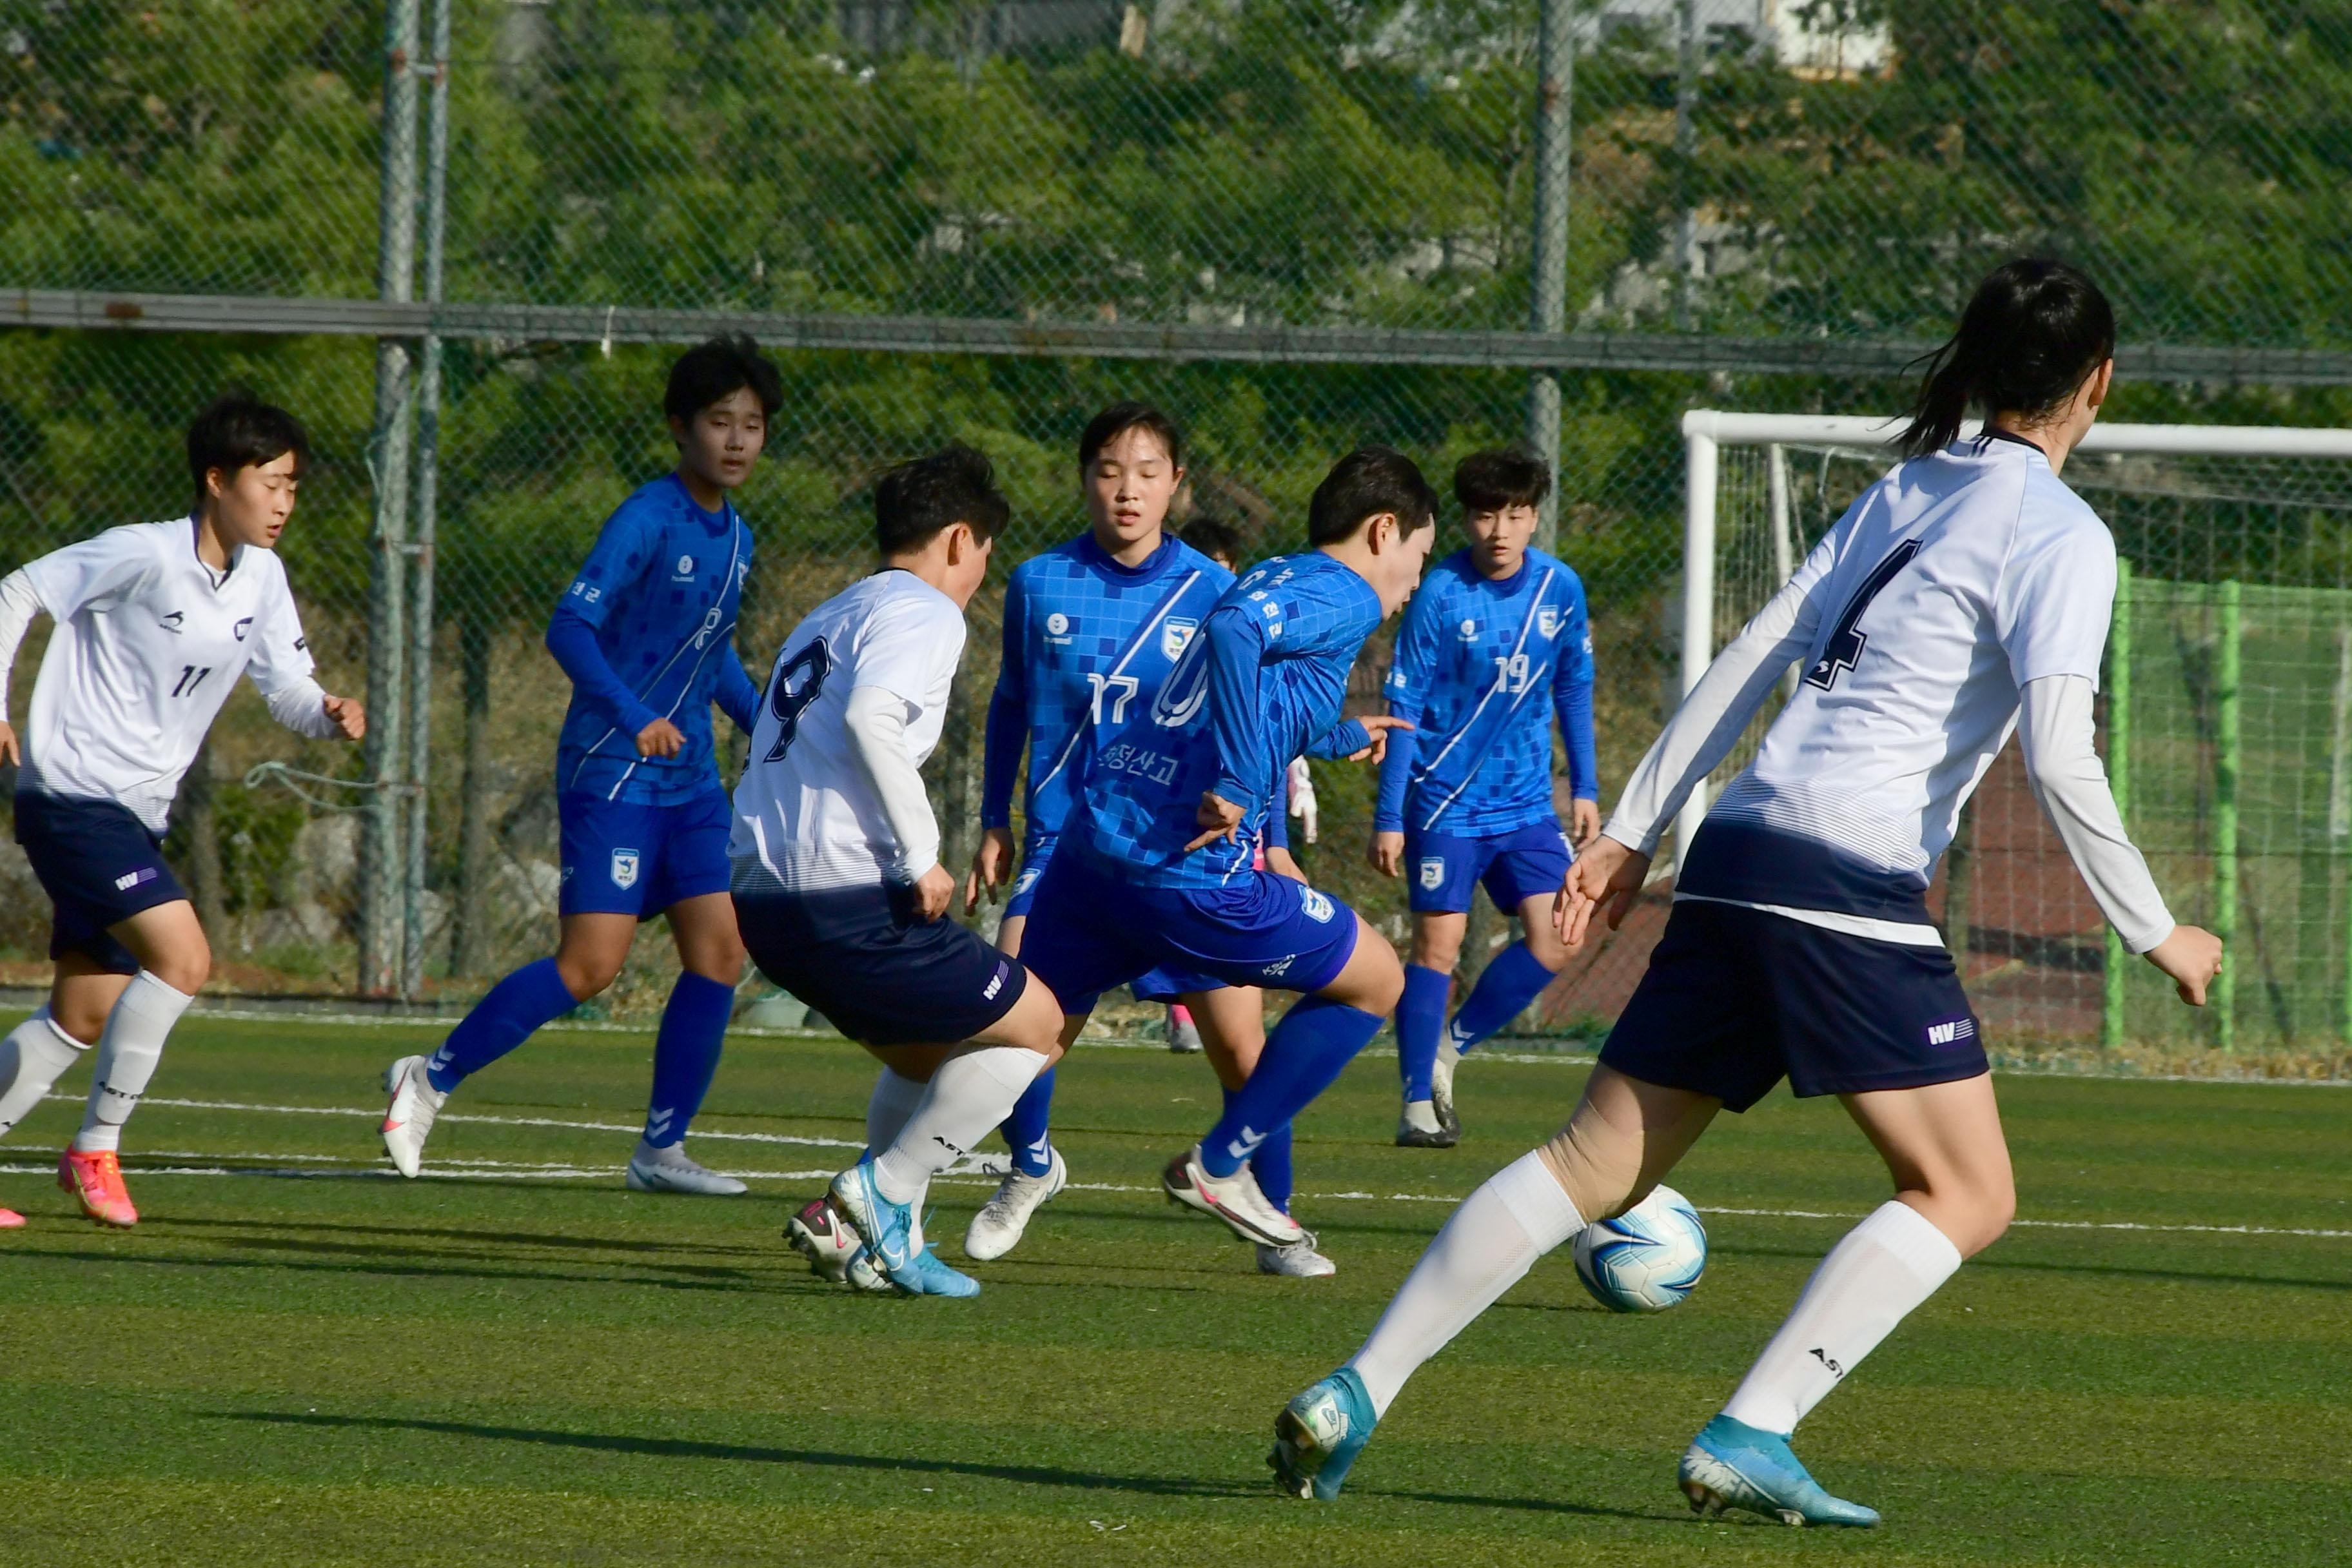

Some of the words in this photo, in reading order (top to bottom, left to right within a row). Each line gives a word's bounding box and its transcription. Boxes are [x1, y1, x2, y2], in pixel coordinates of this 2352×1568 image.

[1804, 539, 1924, 692] 4
[171, 665, 213, 698] 11
[1494, 653, 1530, 693] 19
[763, 635, 831, 763] 9
[1086, 672, 1140, 725] 17
[115, 871, 139, 891] HV
[983, 974, 1003, 1001] HV
[1927, 1022, 1955, 1045] HV
